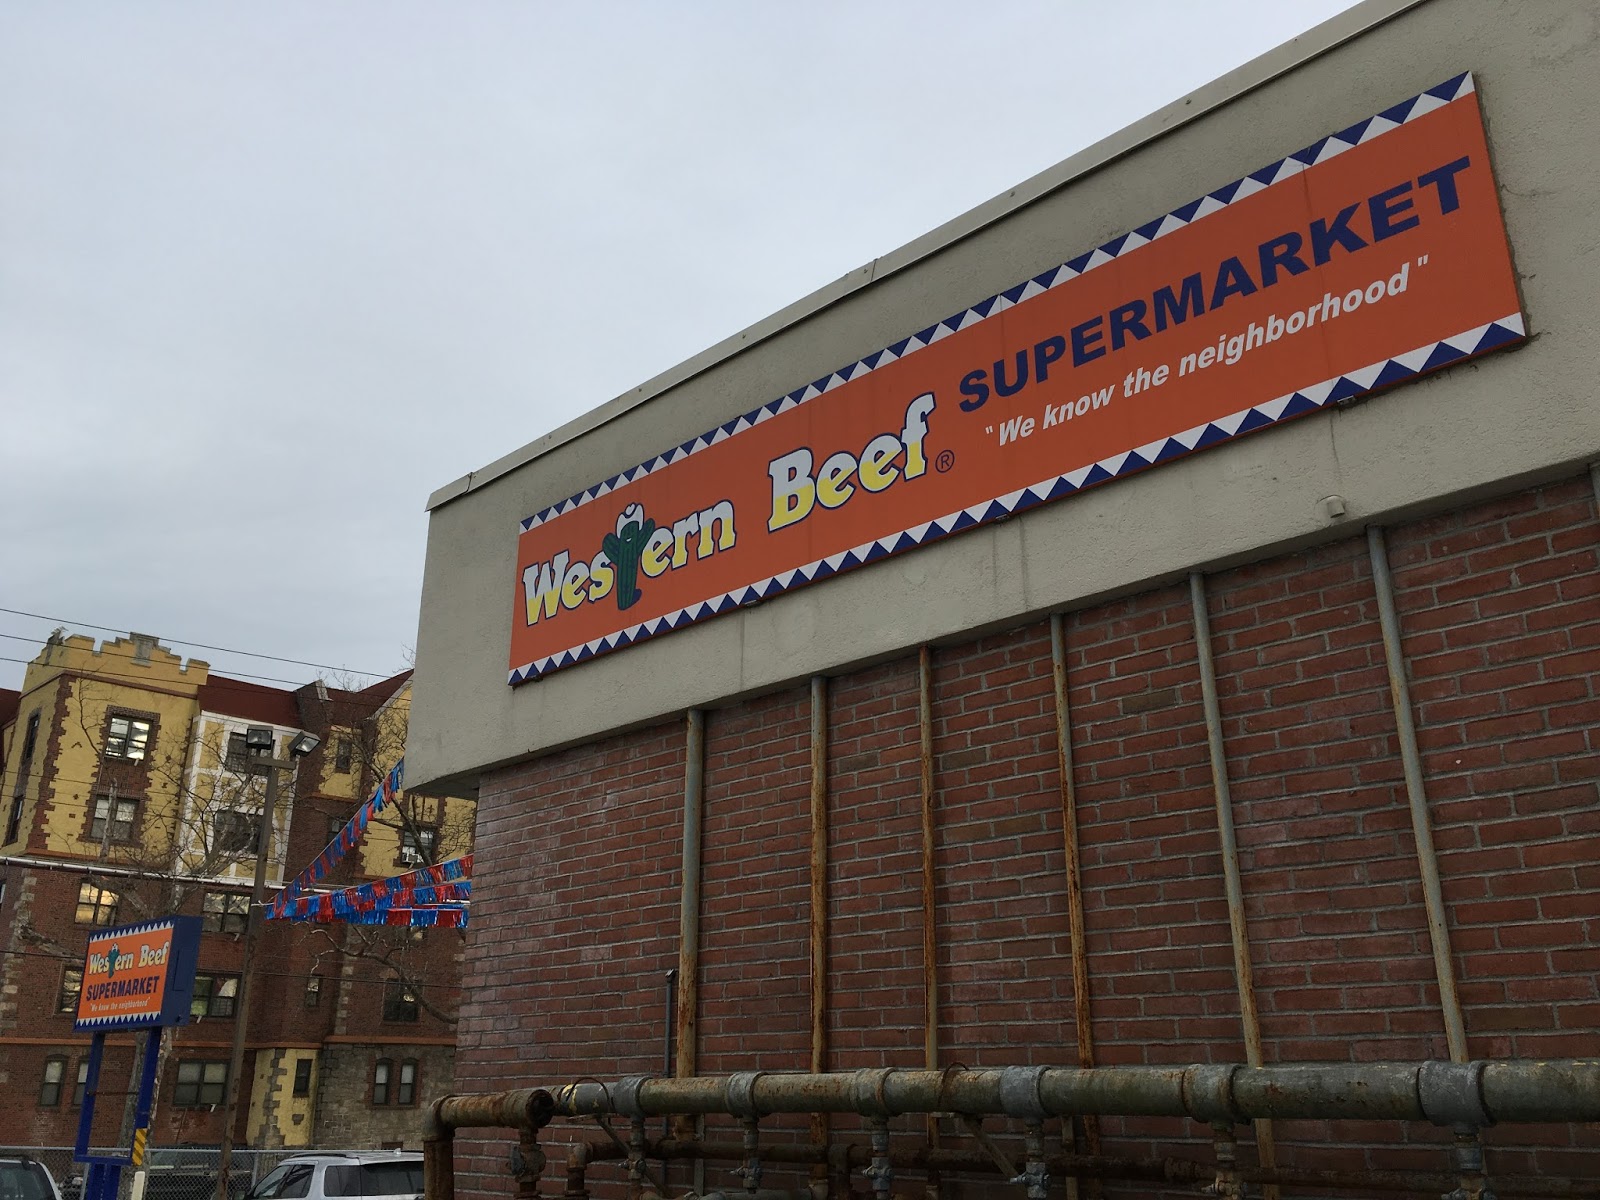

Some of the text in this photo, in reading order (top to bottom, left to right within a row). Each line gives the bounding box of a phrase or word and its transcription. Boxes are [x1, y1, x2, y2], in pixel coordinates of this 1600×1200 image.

[958, 155, 1471, 413] SUPERMARKET
[1042, 385, 1116, 430] know
[1123, 367, 1171, 398] the
[767, 391, 938, 533] Beef
[138, 941, 171, 968] Beef
[86, 976, 160, 1001] SUPERMARKET
